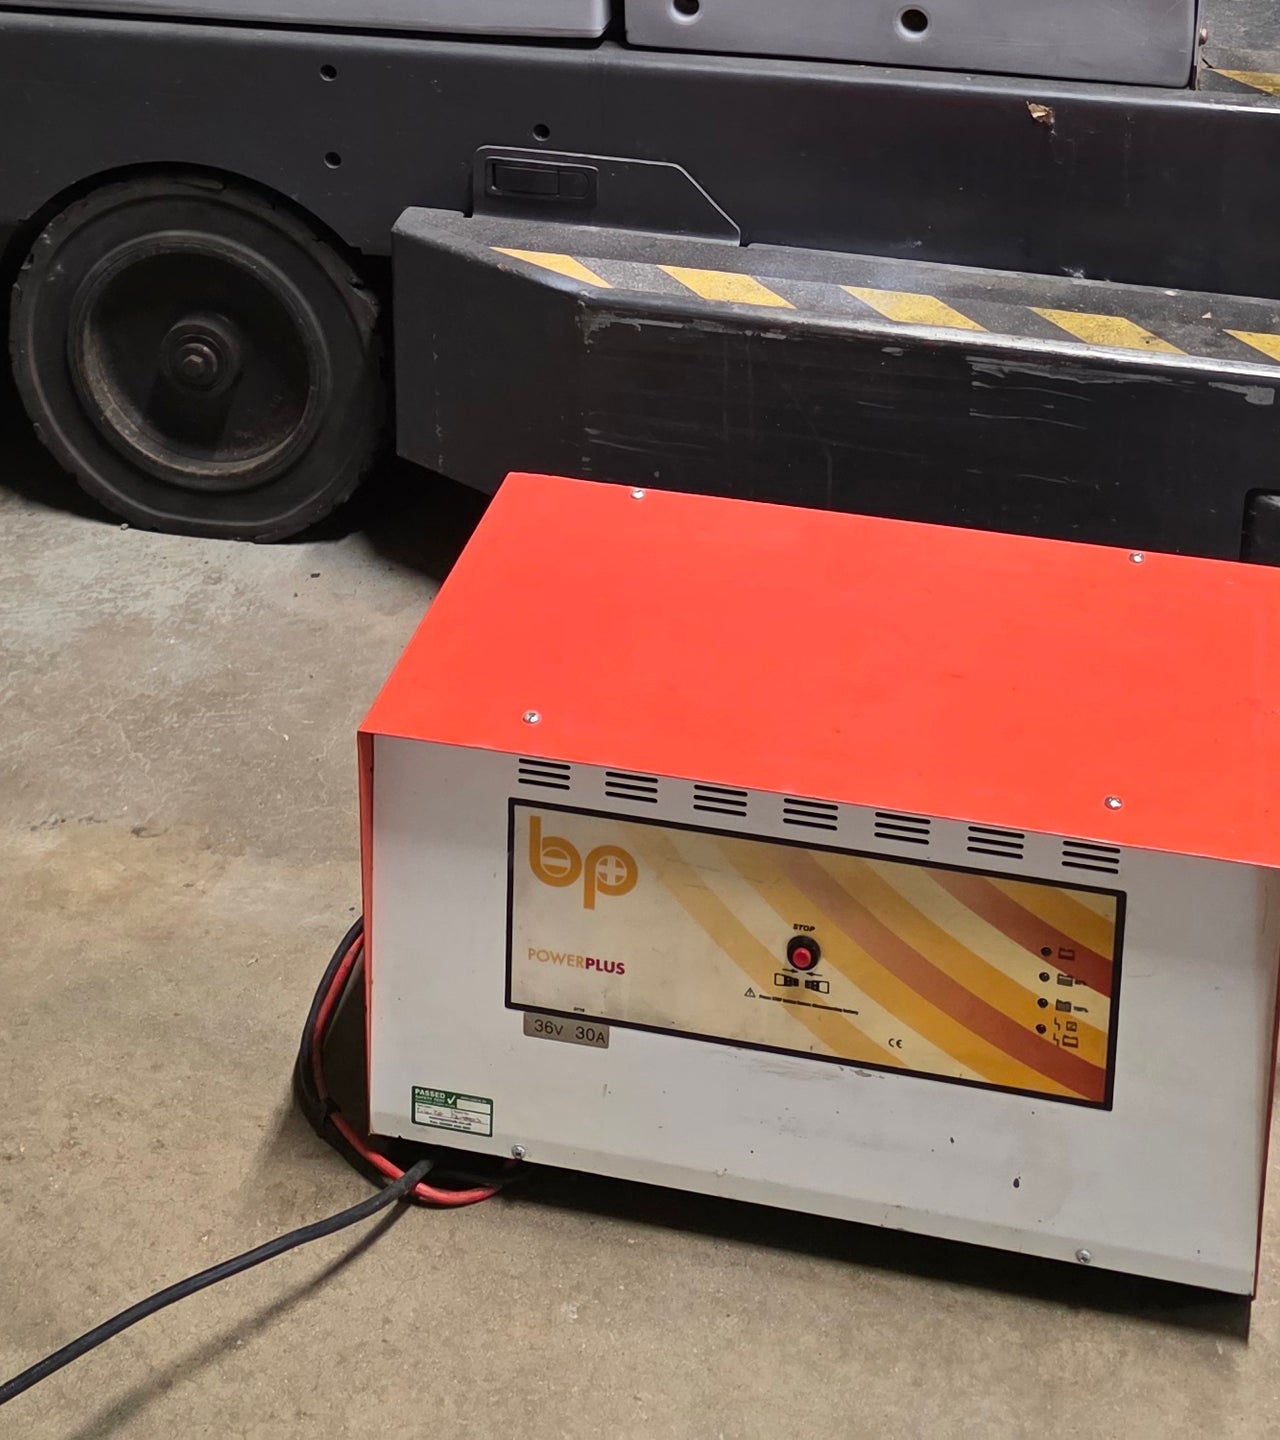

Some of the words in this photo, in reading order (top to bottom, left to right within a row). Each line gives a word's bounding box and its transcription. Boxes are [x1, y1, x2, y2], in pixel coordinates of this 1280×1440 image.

[529, 815, 638, 911] bp
[793, 923, 816, 932] STOP
[534, 1019, 564, 1036] 36V
[575, 1026, 606, 1044] 30A
[415, 1088, 446, 1099] PASSED
